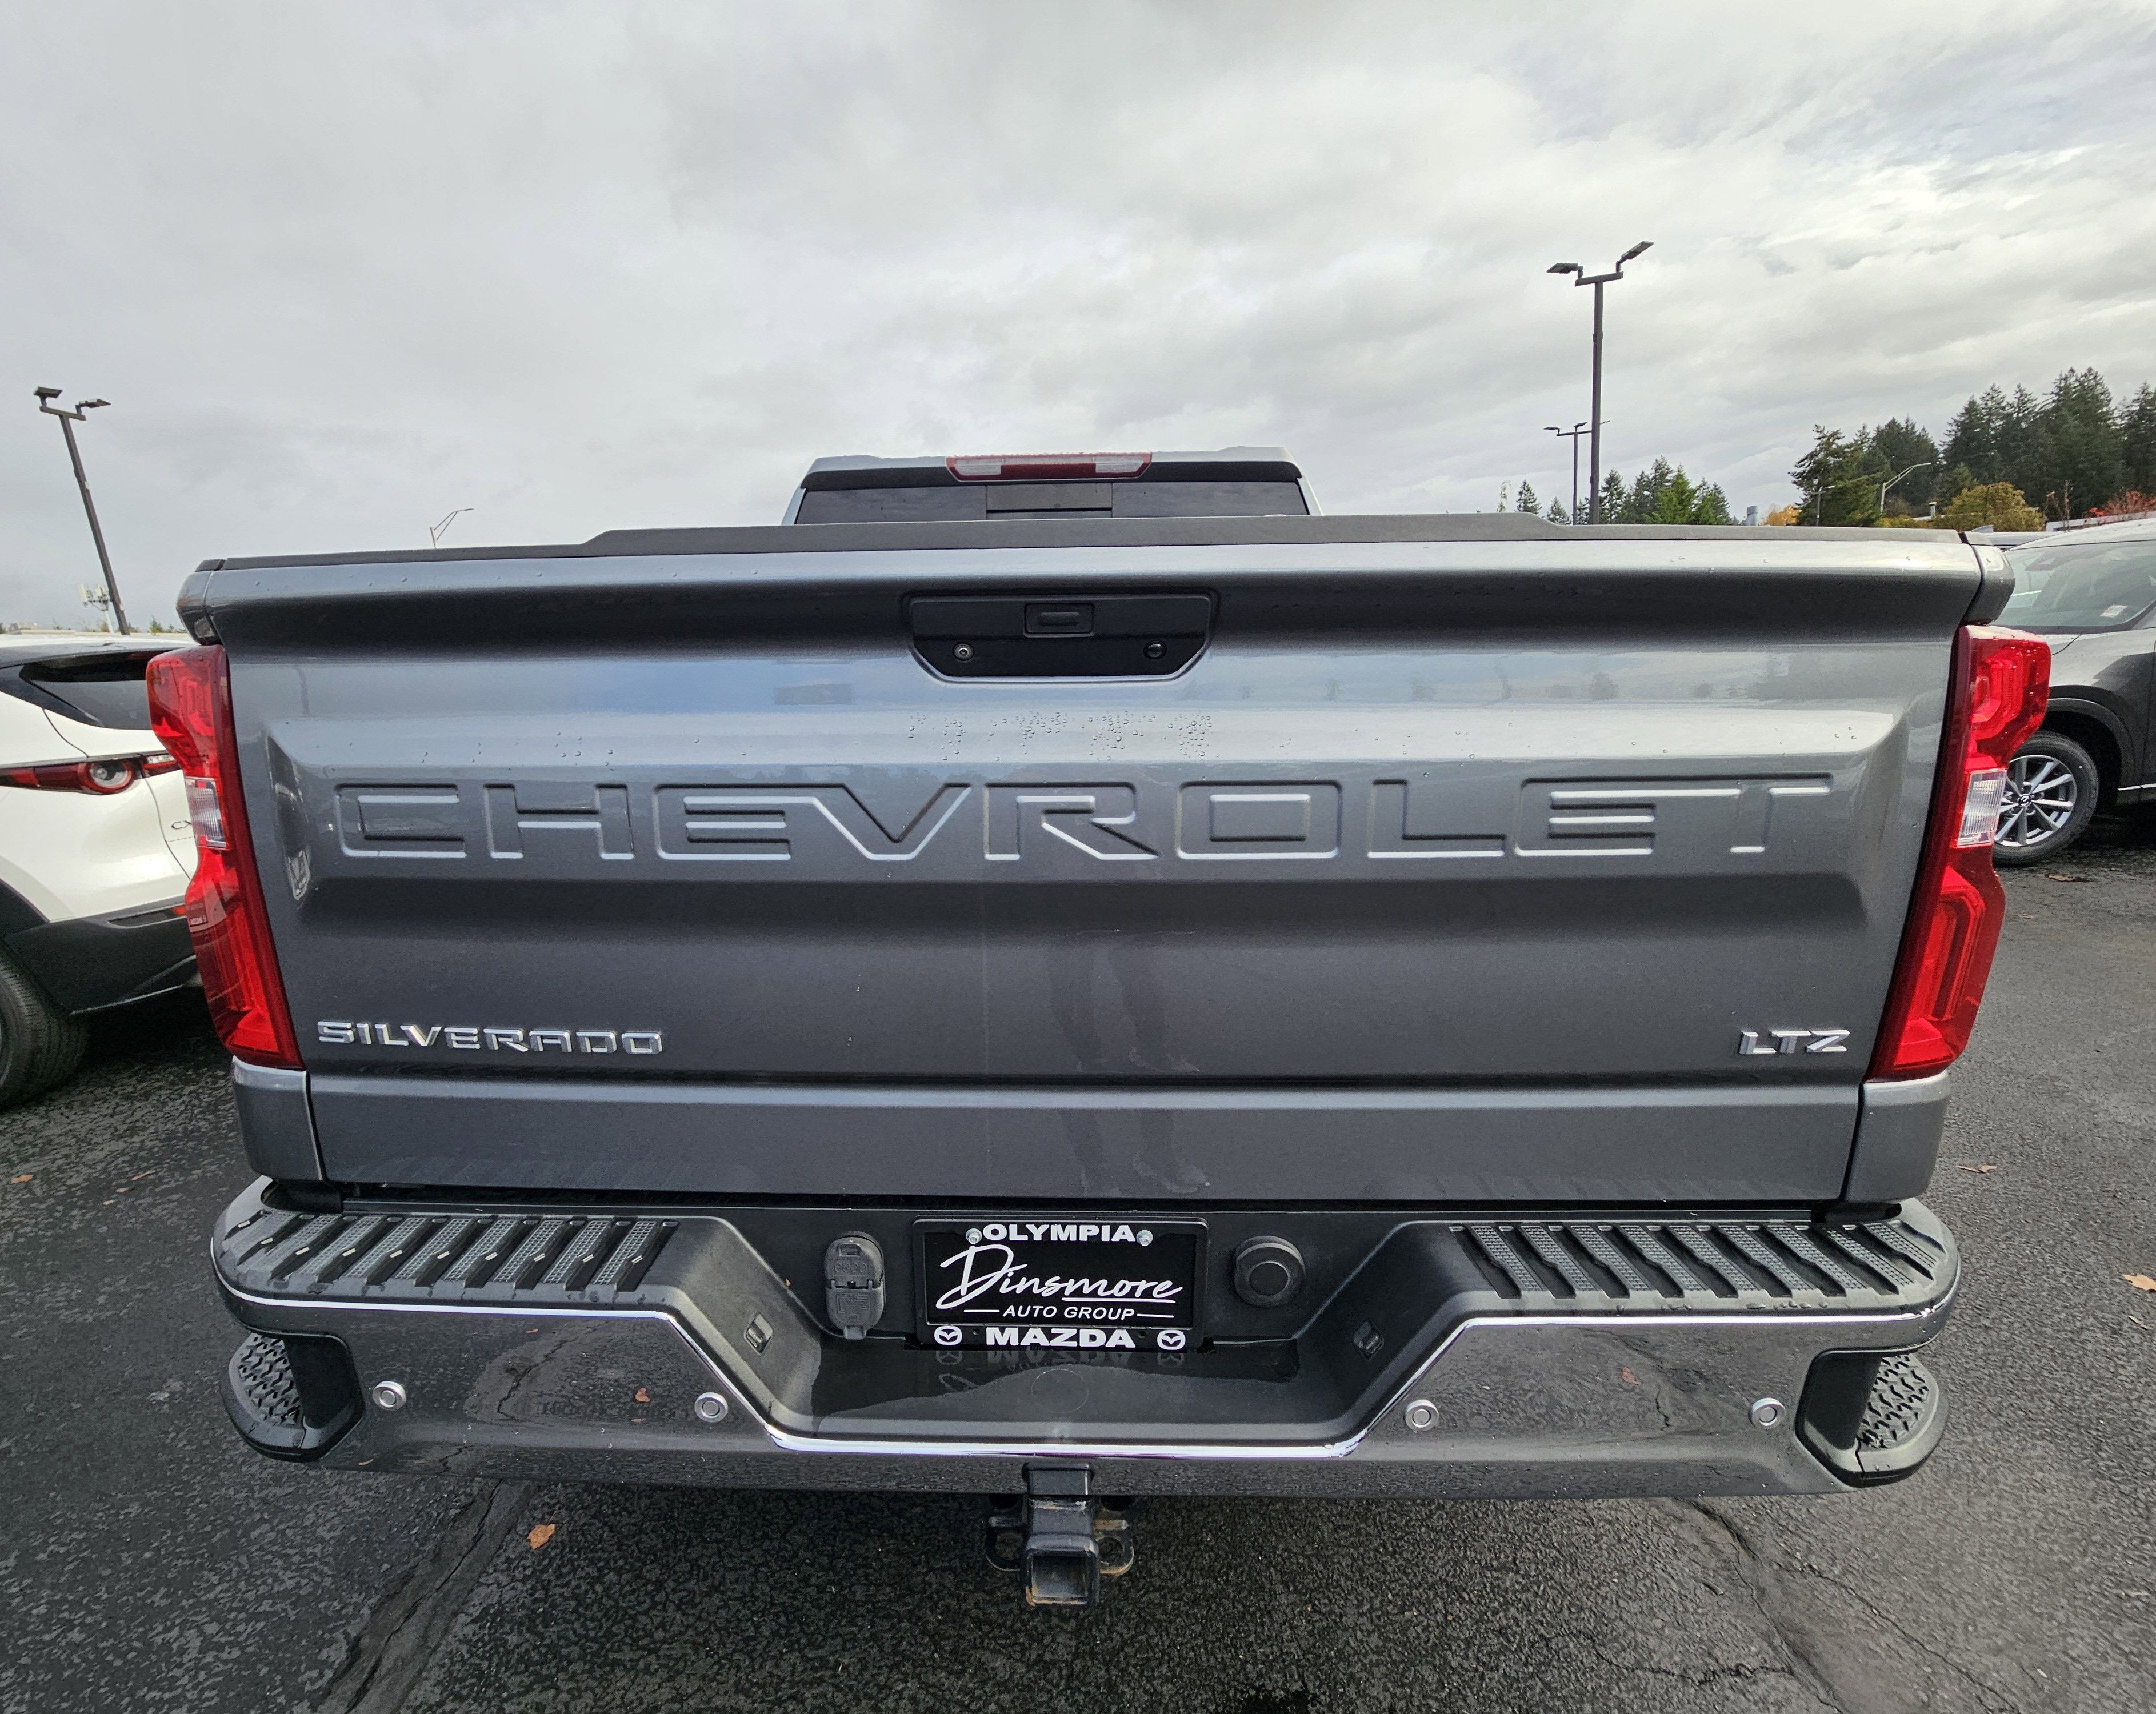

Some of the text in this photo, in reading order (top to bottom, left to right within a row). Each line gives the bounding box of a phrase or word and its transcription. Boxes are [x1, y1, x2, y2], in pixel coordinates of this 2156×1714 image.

[333, 772, 1833, 862] CHEVROLET
[317, 1020, 663, 1055] SILVERADO
[1739, 1030, 1851, 1055] LTZ
[982, 1223, 1136, 1242] OLYMPIA
[935, 1244, 1183, 1309] Dinsmore
[1002, 1305, 1135, 1320] AUTO GROUP
[986, 1327, 1136, 1348] MAZDA
